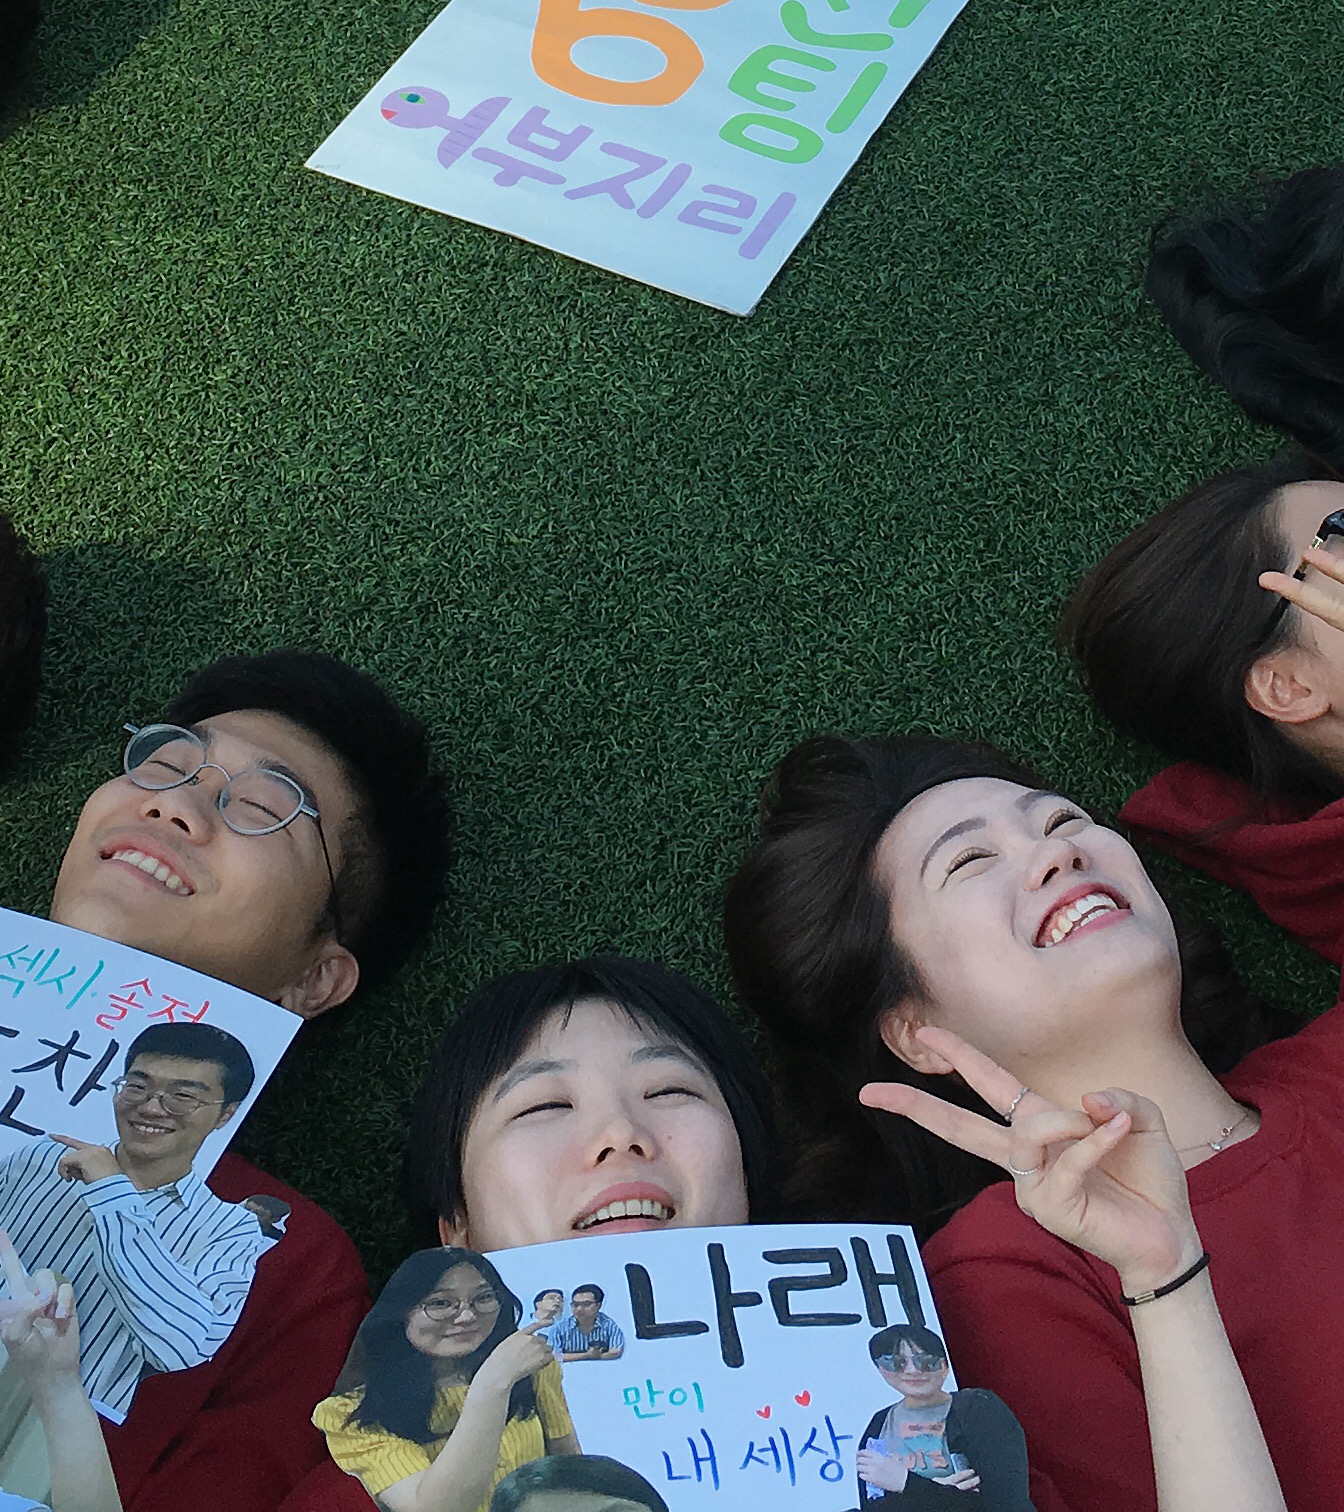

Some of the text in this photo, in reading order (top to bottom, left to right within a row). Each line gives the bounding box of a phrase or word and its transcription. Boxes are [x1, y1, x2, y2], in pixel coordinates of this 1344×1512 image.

[624, 1233, 927, 1368] 나래
[622, 1378, 707, 1420] 만이
[661, 1414, 855, 1491] 내 세상
